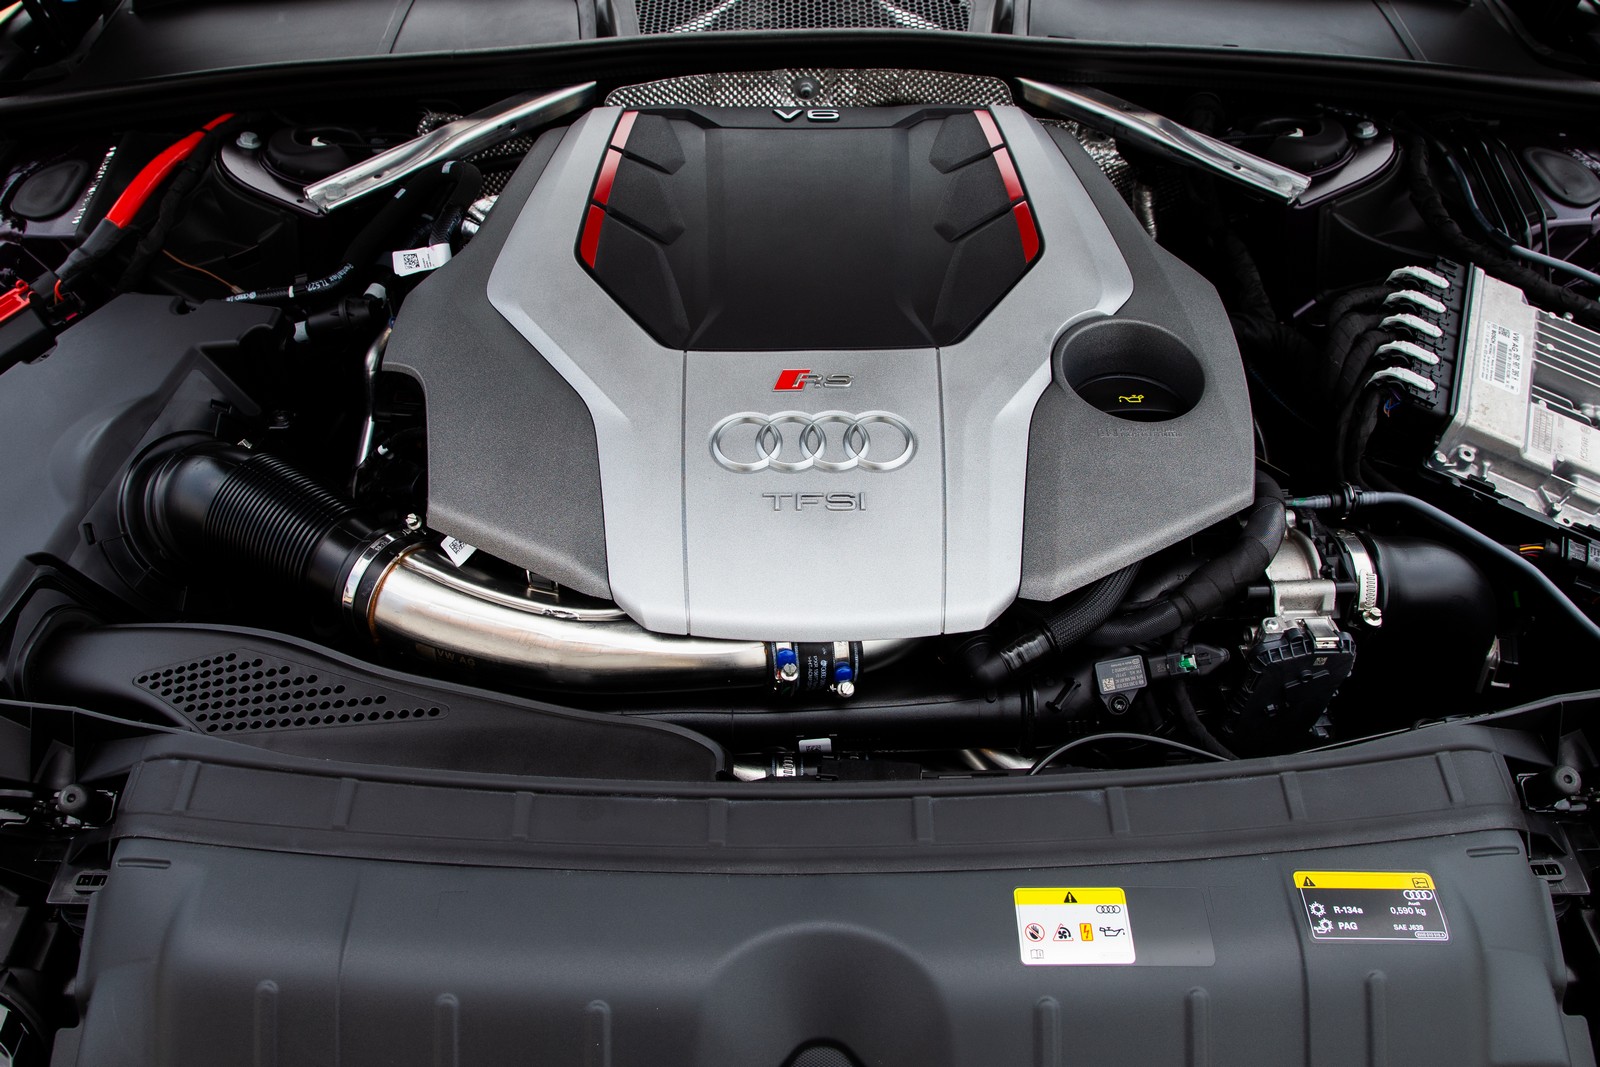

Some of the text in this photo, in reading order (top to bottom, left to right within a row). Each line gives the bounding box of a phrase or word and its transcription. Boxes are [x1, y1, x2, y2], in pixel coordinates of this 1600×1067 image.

[773, 109, 840, 122] V6
[787, 371, 854, 389] RS
[762, 491, 867, 511] TFSI
[1333, 905, 1364, 915] R-134a
[1390, 906, 1427, 916] 0,590 kg
[1338, 921, 1358, 931] PAG
